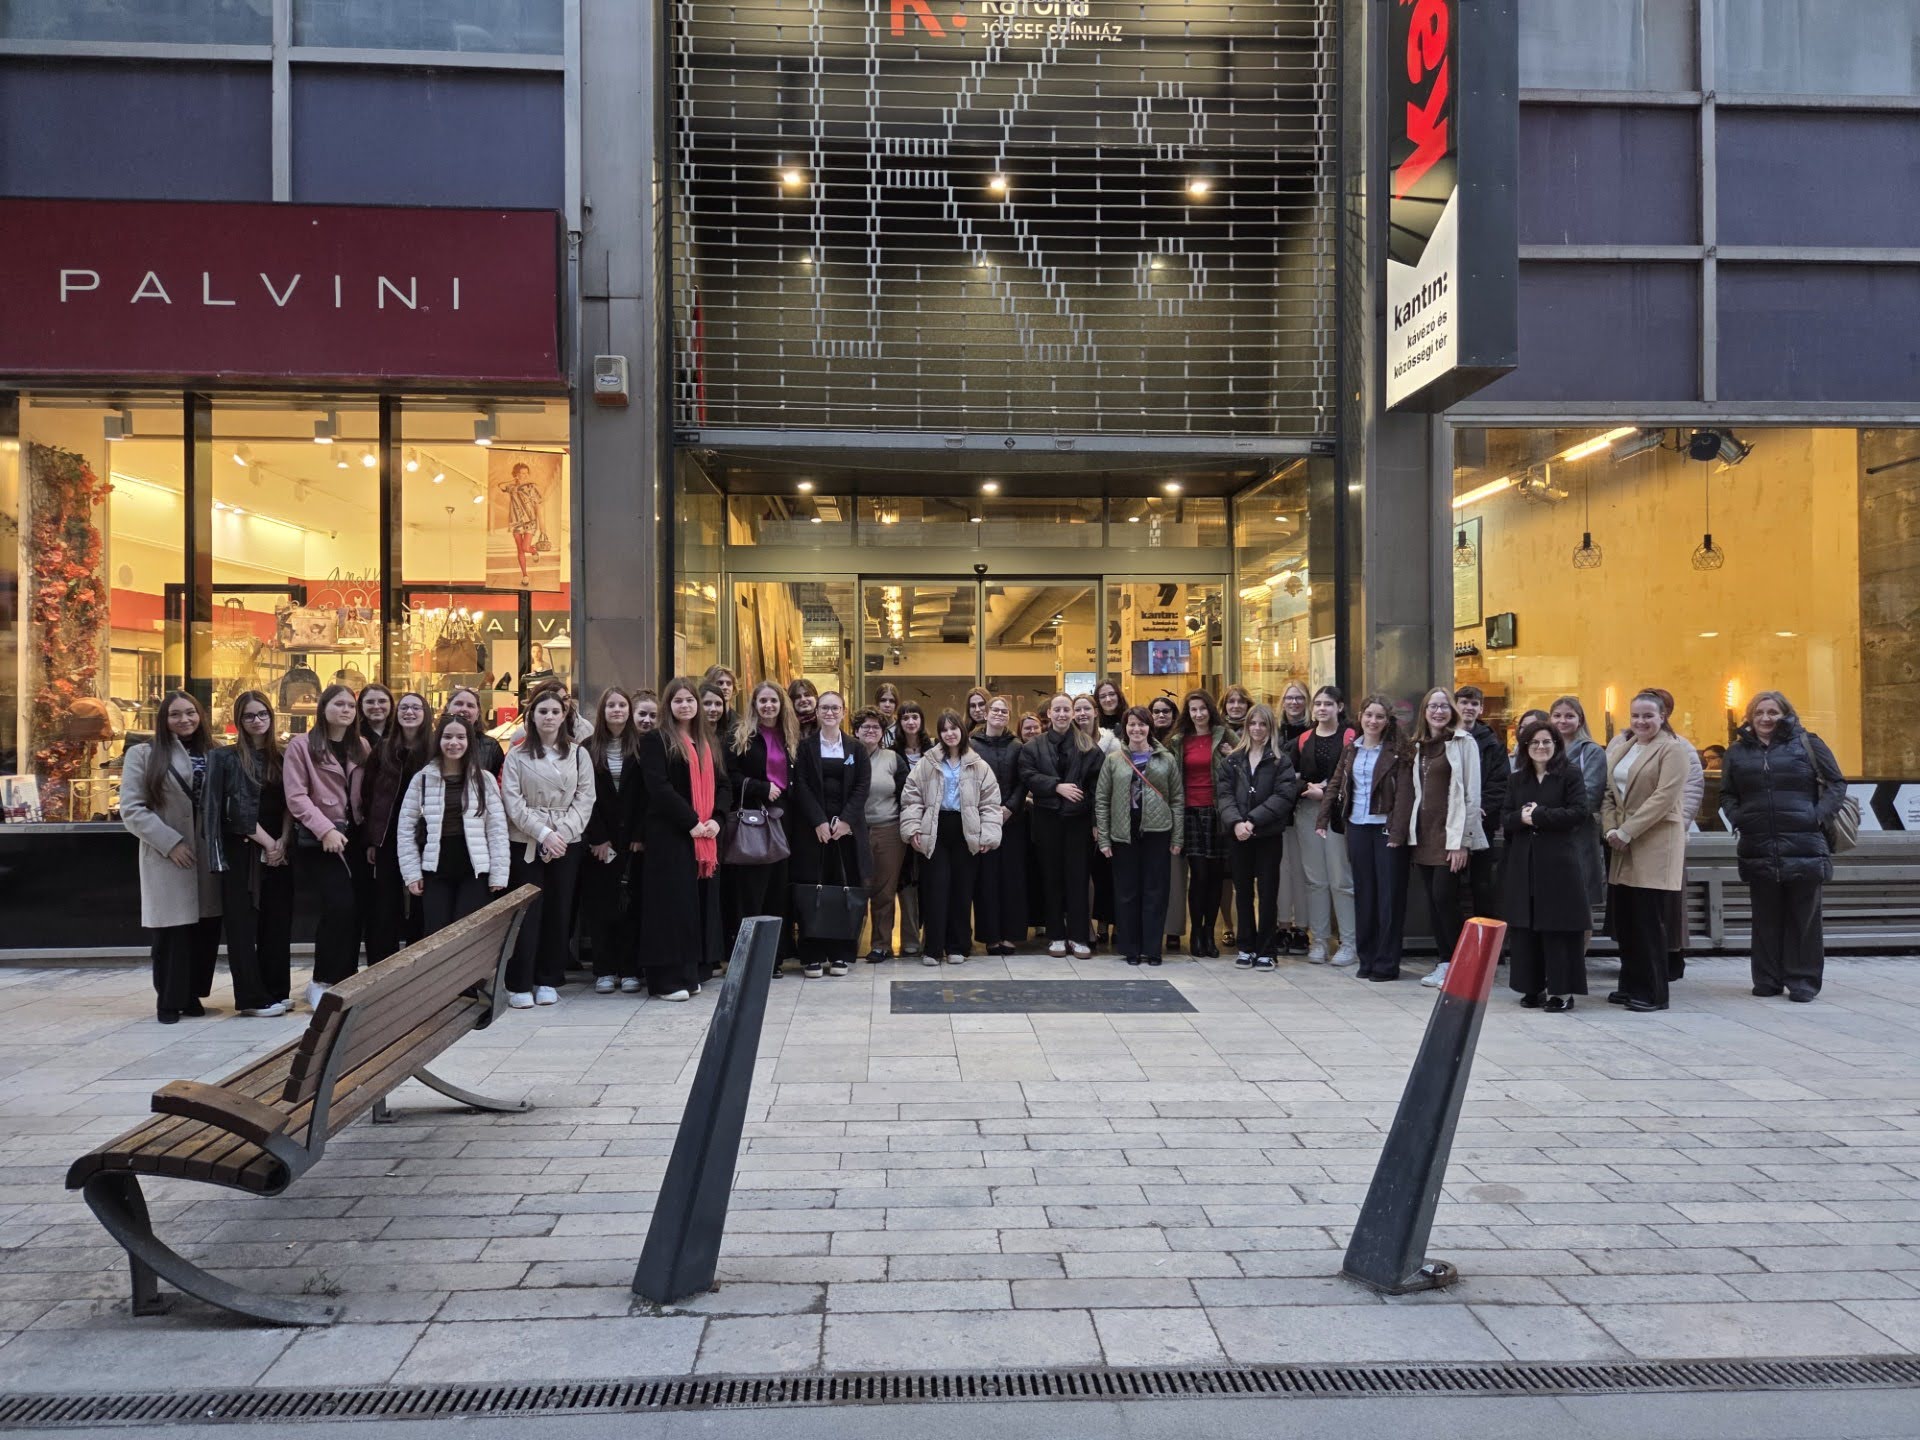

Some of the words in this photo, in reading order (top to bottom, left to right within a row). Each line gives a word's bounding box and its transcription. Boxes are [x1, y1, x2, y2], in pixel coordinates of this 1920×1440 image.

[981, 20, 1044, 40] JÓZSEF
[1048, 22, 1123, 42] SZÍNHÁZ
[60, 269, 460, 311] PALVINI
[1437, 310, 1448, 327] és
[1435, 332, 1448, 352] tér
